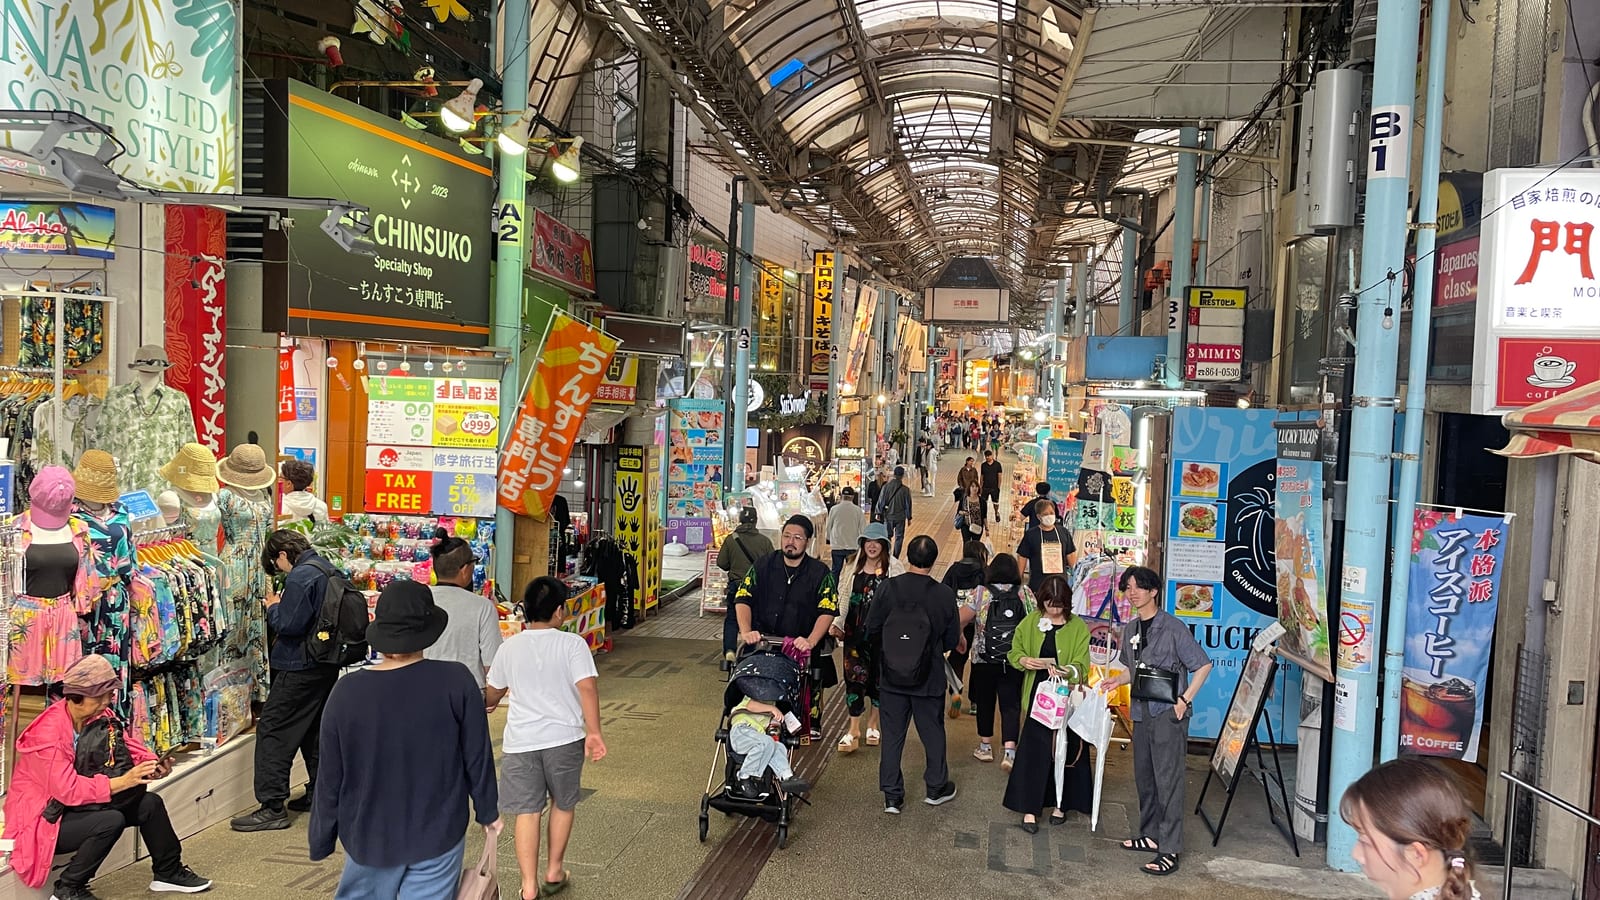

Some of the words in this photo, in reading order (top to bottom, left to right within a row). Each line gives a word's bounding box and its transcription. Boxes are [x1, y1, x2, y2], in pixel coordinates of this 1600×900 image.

[126, 118, 216, 180] STYLE
[431, 184, 449, 198] 2023
[0, 209, 67, 236] Aloha
[374, 213, 472, 263] CHINSUKO
[1514, 218, 1595, 286] 門
[374, 255, 412, 277] Specialty
[413, 262, 433, 279] Shop
[1443, 279, 1471, 300] class
[1573, 286, 1600, 298] MO
[815, 252, 833, 350] トロ肉ソーキそば
[1505, 306, 1563, 319] 音楽と喫茶
[1198, 348, 1241, 360] MIMI'S
[436, 385, 498, 401] 全国配送
[1526, 390, 1562, 400] coff
[529, 340, 608, 491] ちんすこう
[463, 419, 492, 431] ¥999
[1277, 428, 1298, 444] LUCKY
[1298, 428, 1320, 446] TACOS
[434, 453, 496, 469] 修学旅行生
[499, 413, 548, 502] 専門店
[383, 473, 417, 488] TAX
[454, 473, 475, 485] 全品
[376, 493, 422, 510] FREE
[448, 487, 480, 503] 5%
[452, 503, 474, 514] OFF
[1467, 528, 1502, 603] 本格派
[1231, 569, 1273, 603] OKINAWAN
[1424, 528, 1472, 679] アイスコーヒー
[1188, 624, 1277, 650] LUCK
[1416, 736, 1464, 752] COFFEE
